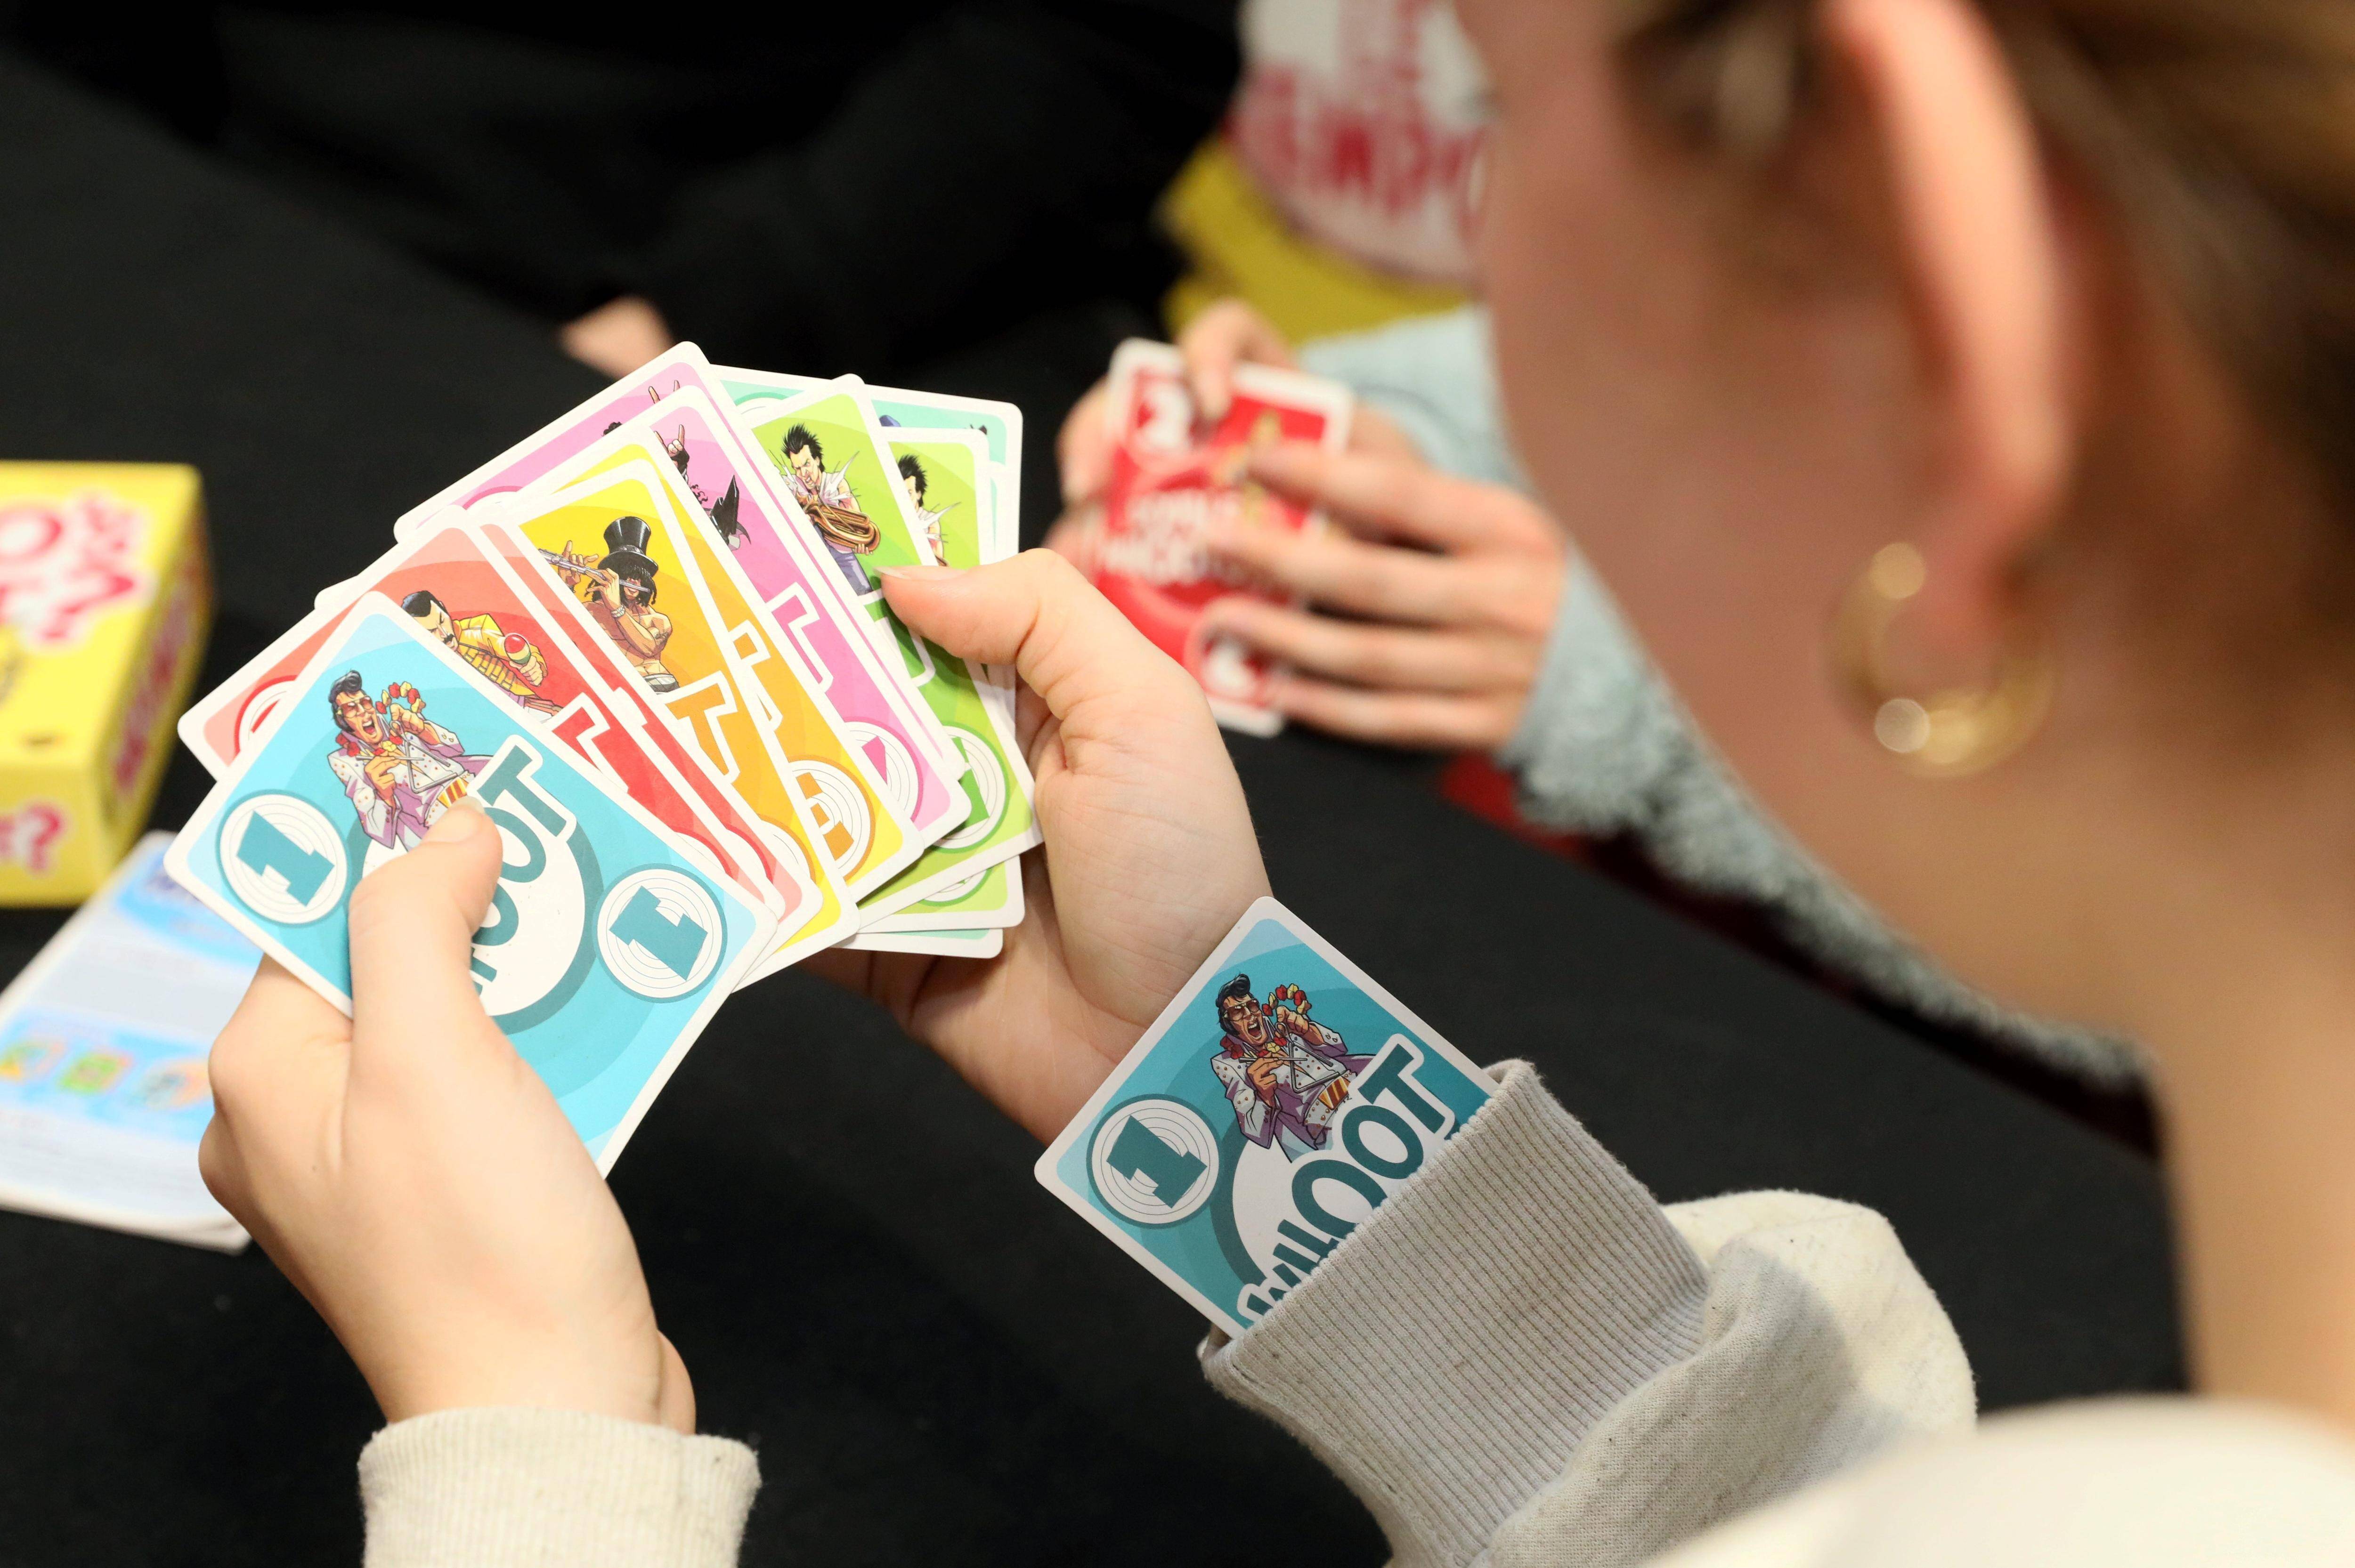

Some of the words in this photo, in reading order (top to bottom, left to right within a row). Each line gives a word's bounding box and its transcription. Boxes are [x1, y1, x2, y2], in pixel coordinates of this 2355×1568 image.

[236, 810, 335, 907] 1
[609, 885, 708, 981] 1
[1105, 1115, 1208, 1209] 1
